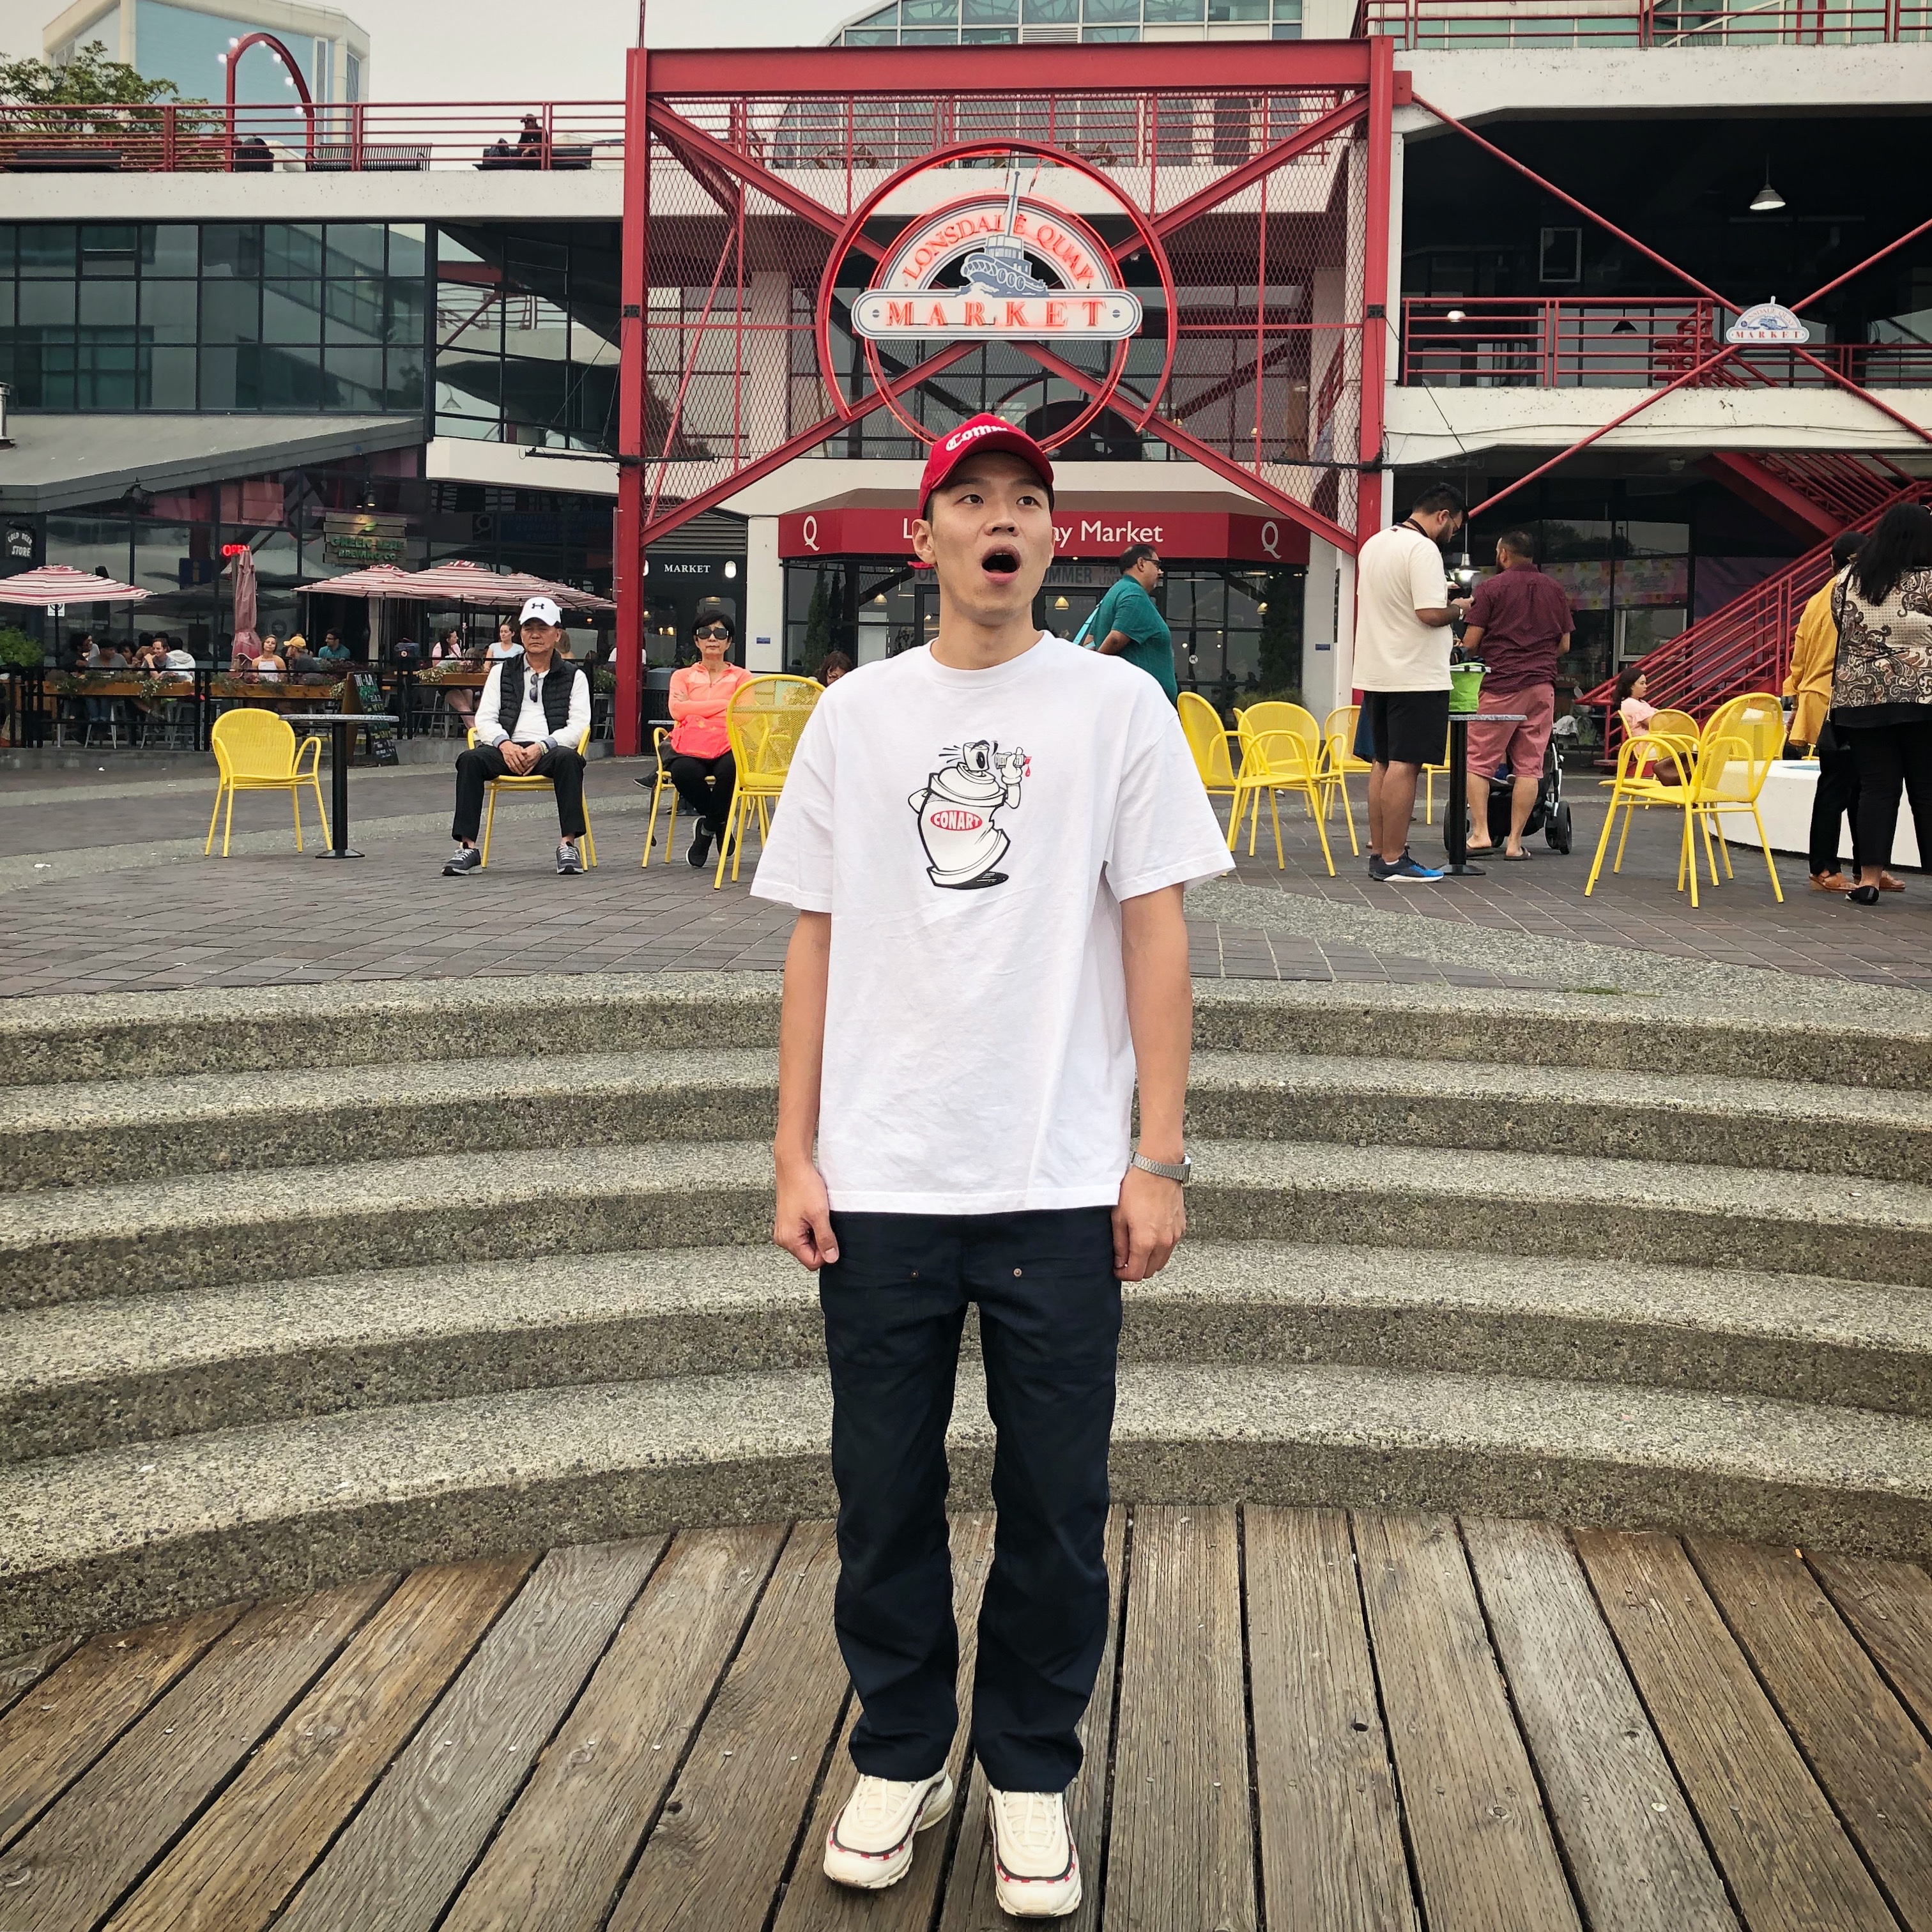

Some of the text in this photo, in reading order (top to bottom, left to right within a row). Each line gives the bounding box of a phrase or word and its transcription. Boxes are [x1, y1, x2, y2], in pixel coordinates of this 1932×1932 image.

[903, 214, 1094, 281] LONSDALE QUAY
[885, 300, 1107, 327] MARKET
[803, 515, 820, 551] Q
[1081, 520, 1163, 543] Market
[1261, 521, 1282, 559] Q
[12, 545, 31, 557] STORE
[330, 536, 372, 549] GREEN
[338, 549, 381, 560] BREWING
[664, 564, 711, 573] MARKET
[933, 811, 981, 831] CONART
